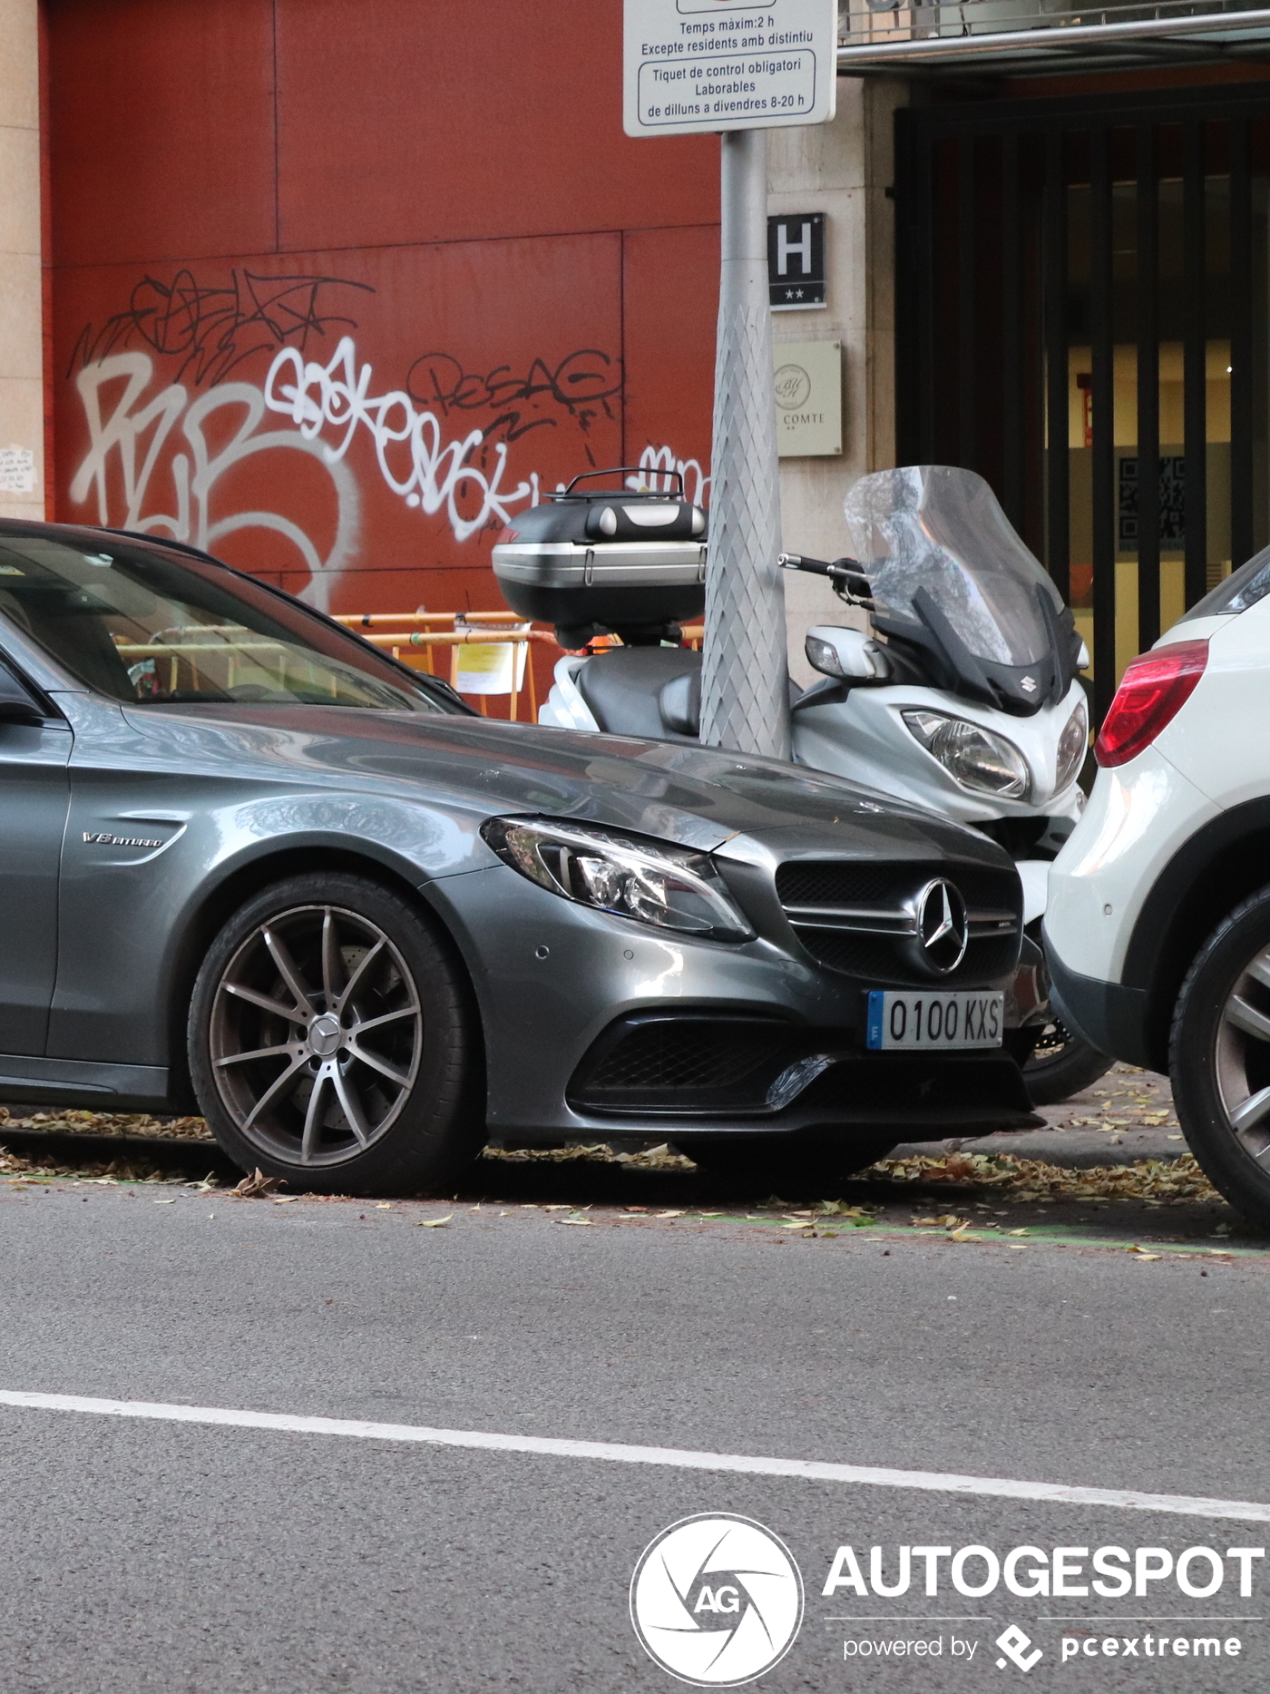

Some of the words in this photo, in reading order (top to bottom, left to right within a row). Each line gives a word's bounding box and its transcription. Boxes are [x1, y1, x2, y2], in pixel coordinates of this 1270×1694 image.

[680, 22, 715, 36] Temps
[767, 15, 775, 27] h
[641, 41, 684, 57] Excepte
[687, 37, 738, 52] residents
[741, 34, 765, 48] amb
[768, 30, 814, 46] distintiu
[652, 67, 687, 84] Tiquet
[689, 66, 703, 79] de
[706, 62, 745, 77] control
[748, 57, 802, 76] obligatori
[695, 80, 756, 96] Laborables
[647, 105, 661, 118] de
[664, 102, 701, 116] dilluns
[703, 102, 710, 113] a
[713, 98, 768, 113] divendres
[770, 95, 795, 108] 8-20
[797, 94, 805, 106] h
[777, 222, 812, 276] H
[783, 412, 825, 425] COMTE
[889, 999, 959, 1042] 0100
[963, 999, 999, 1040] KXS
